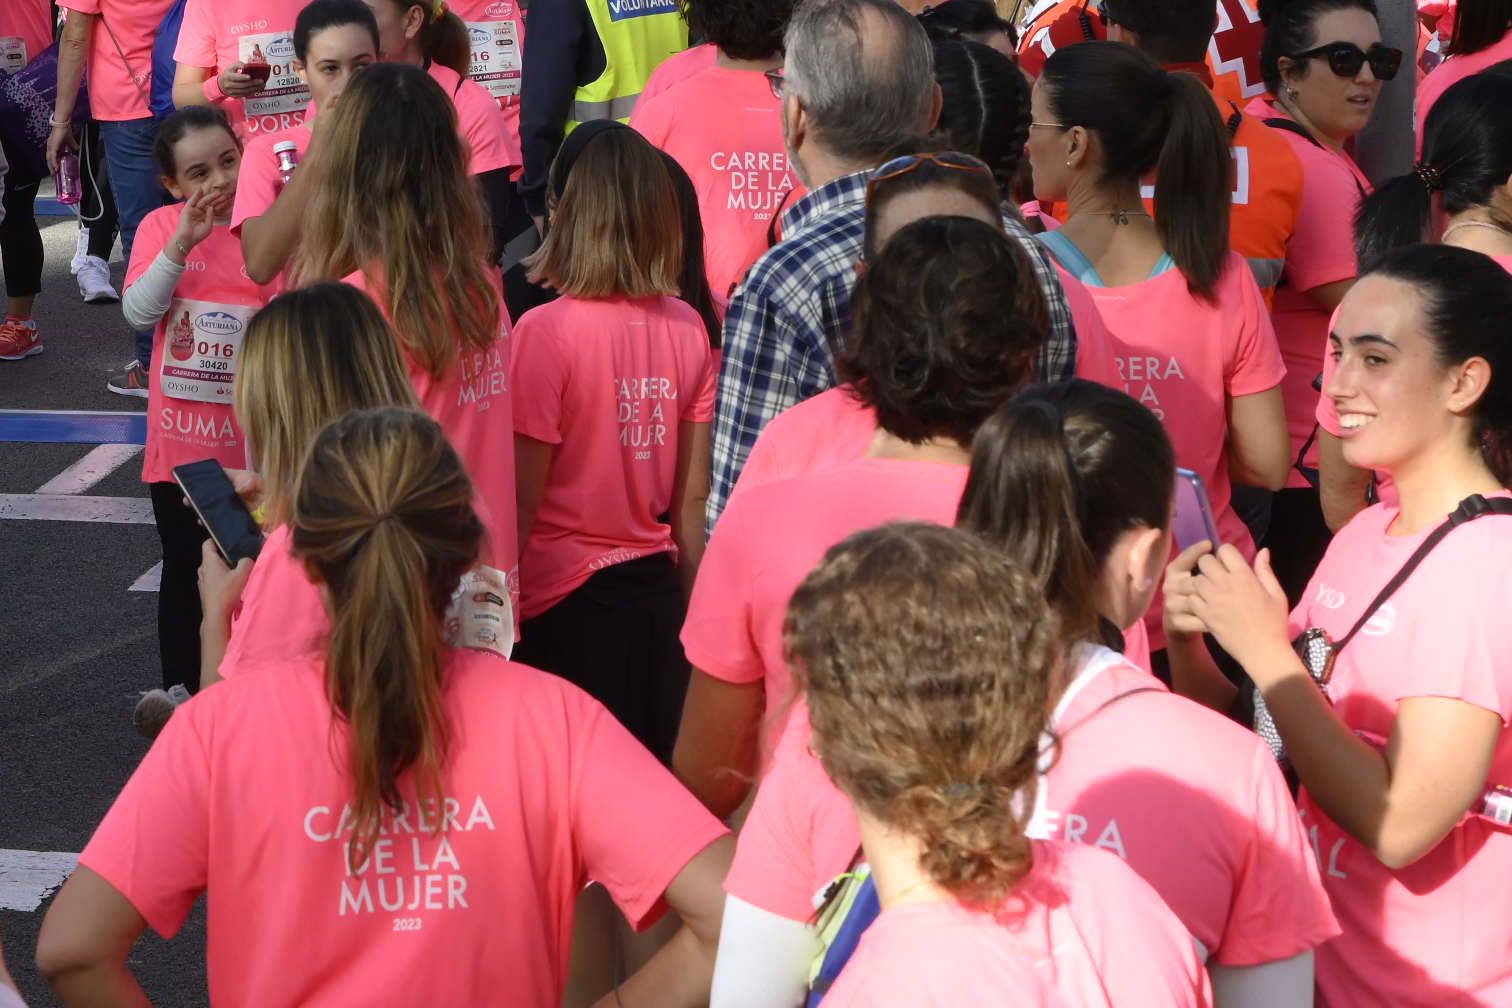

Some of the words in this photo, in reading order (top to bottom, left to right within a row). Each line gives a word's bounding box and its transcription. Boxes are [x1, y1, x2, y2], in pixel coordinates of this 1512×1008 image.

[731, 171, 759, 190] DE
[768, 172, 794, 191] LA
[199, 317, 239, 330] ASTURIANA
[197, 342, 234, 359] 016
[199, 359, 229, 371] 30420
[171, 368, 200, 379] CARRERA
[167, 381, 199, 394] OYSHO
[160, 407, 235, 440] SUMA
[411, 834, 461, 871] LA
[338, 873, 470, 918] MUJER
[392, 918, 423, 932] 2023
